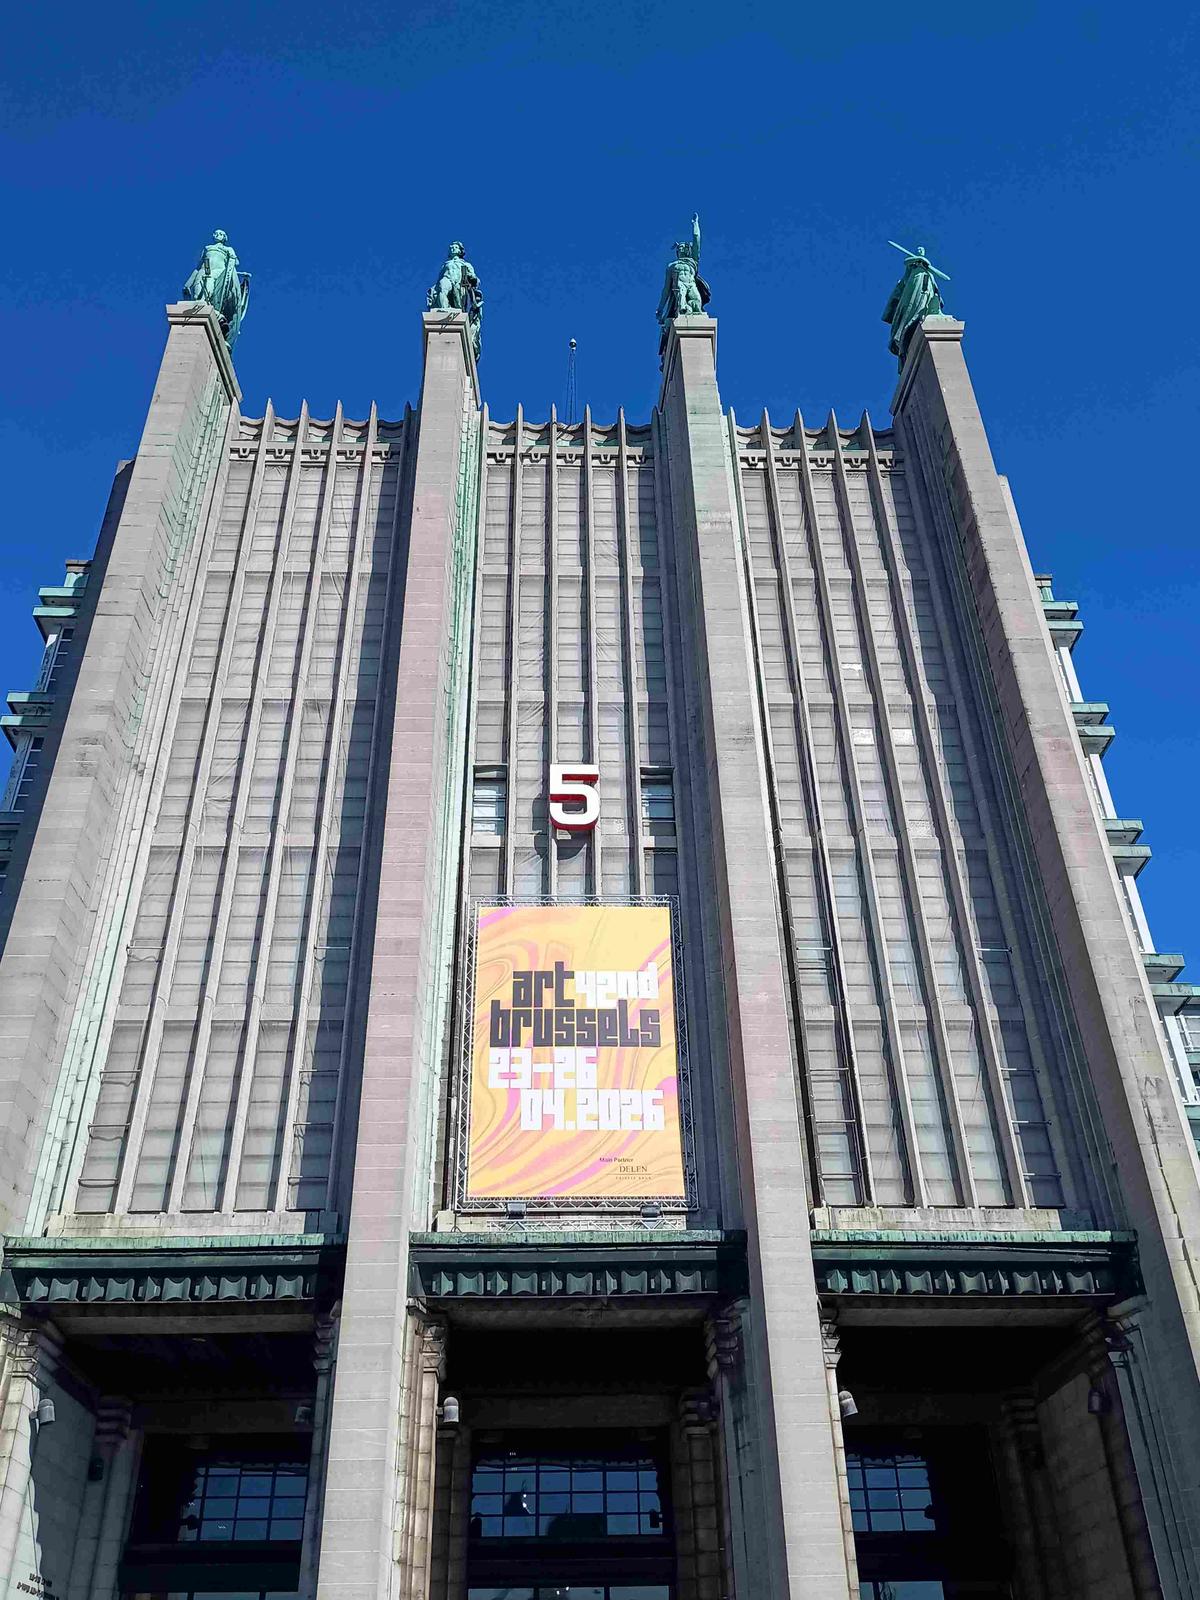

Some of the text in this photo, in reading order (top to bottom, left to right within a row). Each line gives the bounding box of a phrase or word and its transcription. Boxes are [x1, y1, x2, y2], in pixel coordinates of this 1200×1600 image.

[549, 763, 600, 830] 5
[512, 961, 659, 1007] art 42nd
[489, 999, 662, 1048] brussels
[488, 1047, 598, 1088] 23-26
[520, 1088, 665, 1131] 04.2026
[619, 1165, 648, 1173] DELEN
